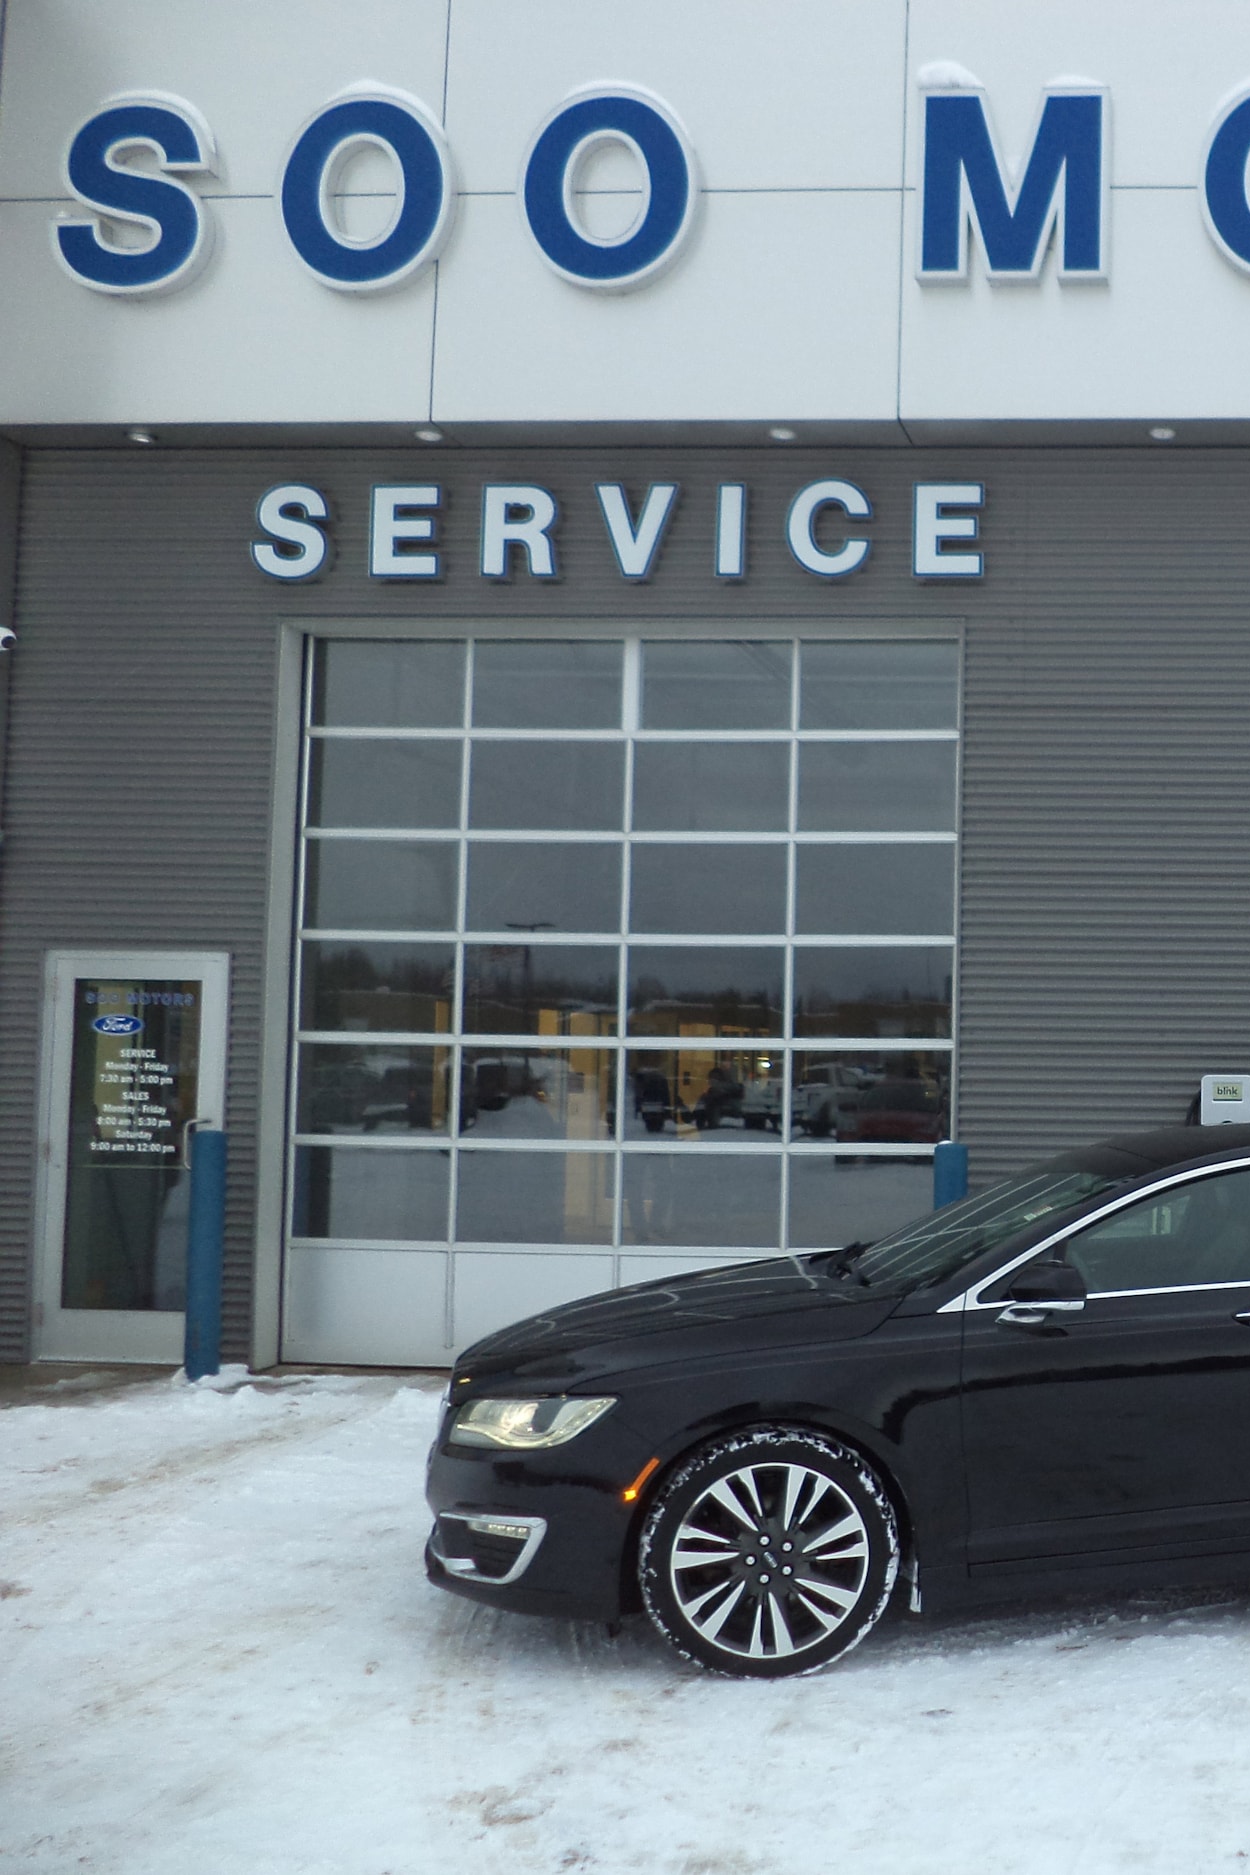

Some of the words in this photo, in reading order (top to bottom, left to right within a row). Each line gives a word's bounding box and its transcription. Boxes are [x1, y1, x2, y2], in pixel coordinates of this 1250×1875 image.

[56, 94, 690, 288] SOO
[251, 480, 987, 580] SERVICE
[127, 993, 194, 1006] MOTORS
[102, 1017, 134, 1031] Ford
[120, 1049, 156, 1058] SERVICE
[105, 1062, 138, 1072] Monday
[144, 1062, 169, 1073] Friday
[140, 1075, 159, 1084] 5:00
[160, 1077, 173, 1085] pm
[122, 1091, 149, 1100] SALES
[1217, 1086, 1238, 1095] blink
[103, 1104, 135, 1114] Monday
[142, 1105, 167, 1115] Friday
[118, 1118, 131, 1126] am
[158, 1120, 171, 1128] pm
[115, 1130, 153, 1140] Saturday
[90, 1142, 110, 1151] 9:00
[126, 1143, 135, 1151] to
[137, 1143, 160, 1152] 12:00
[162, 1145, 175, 1153] pm
